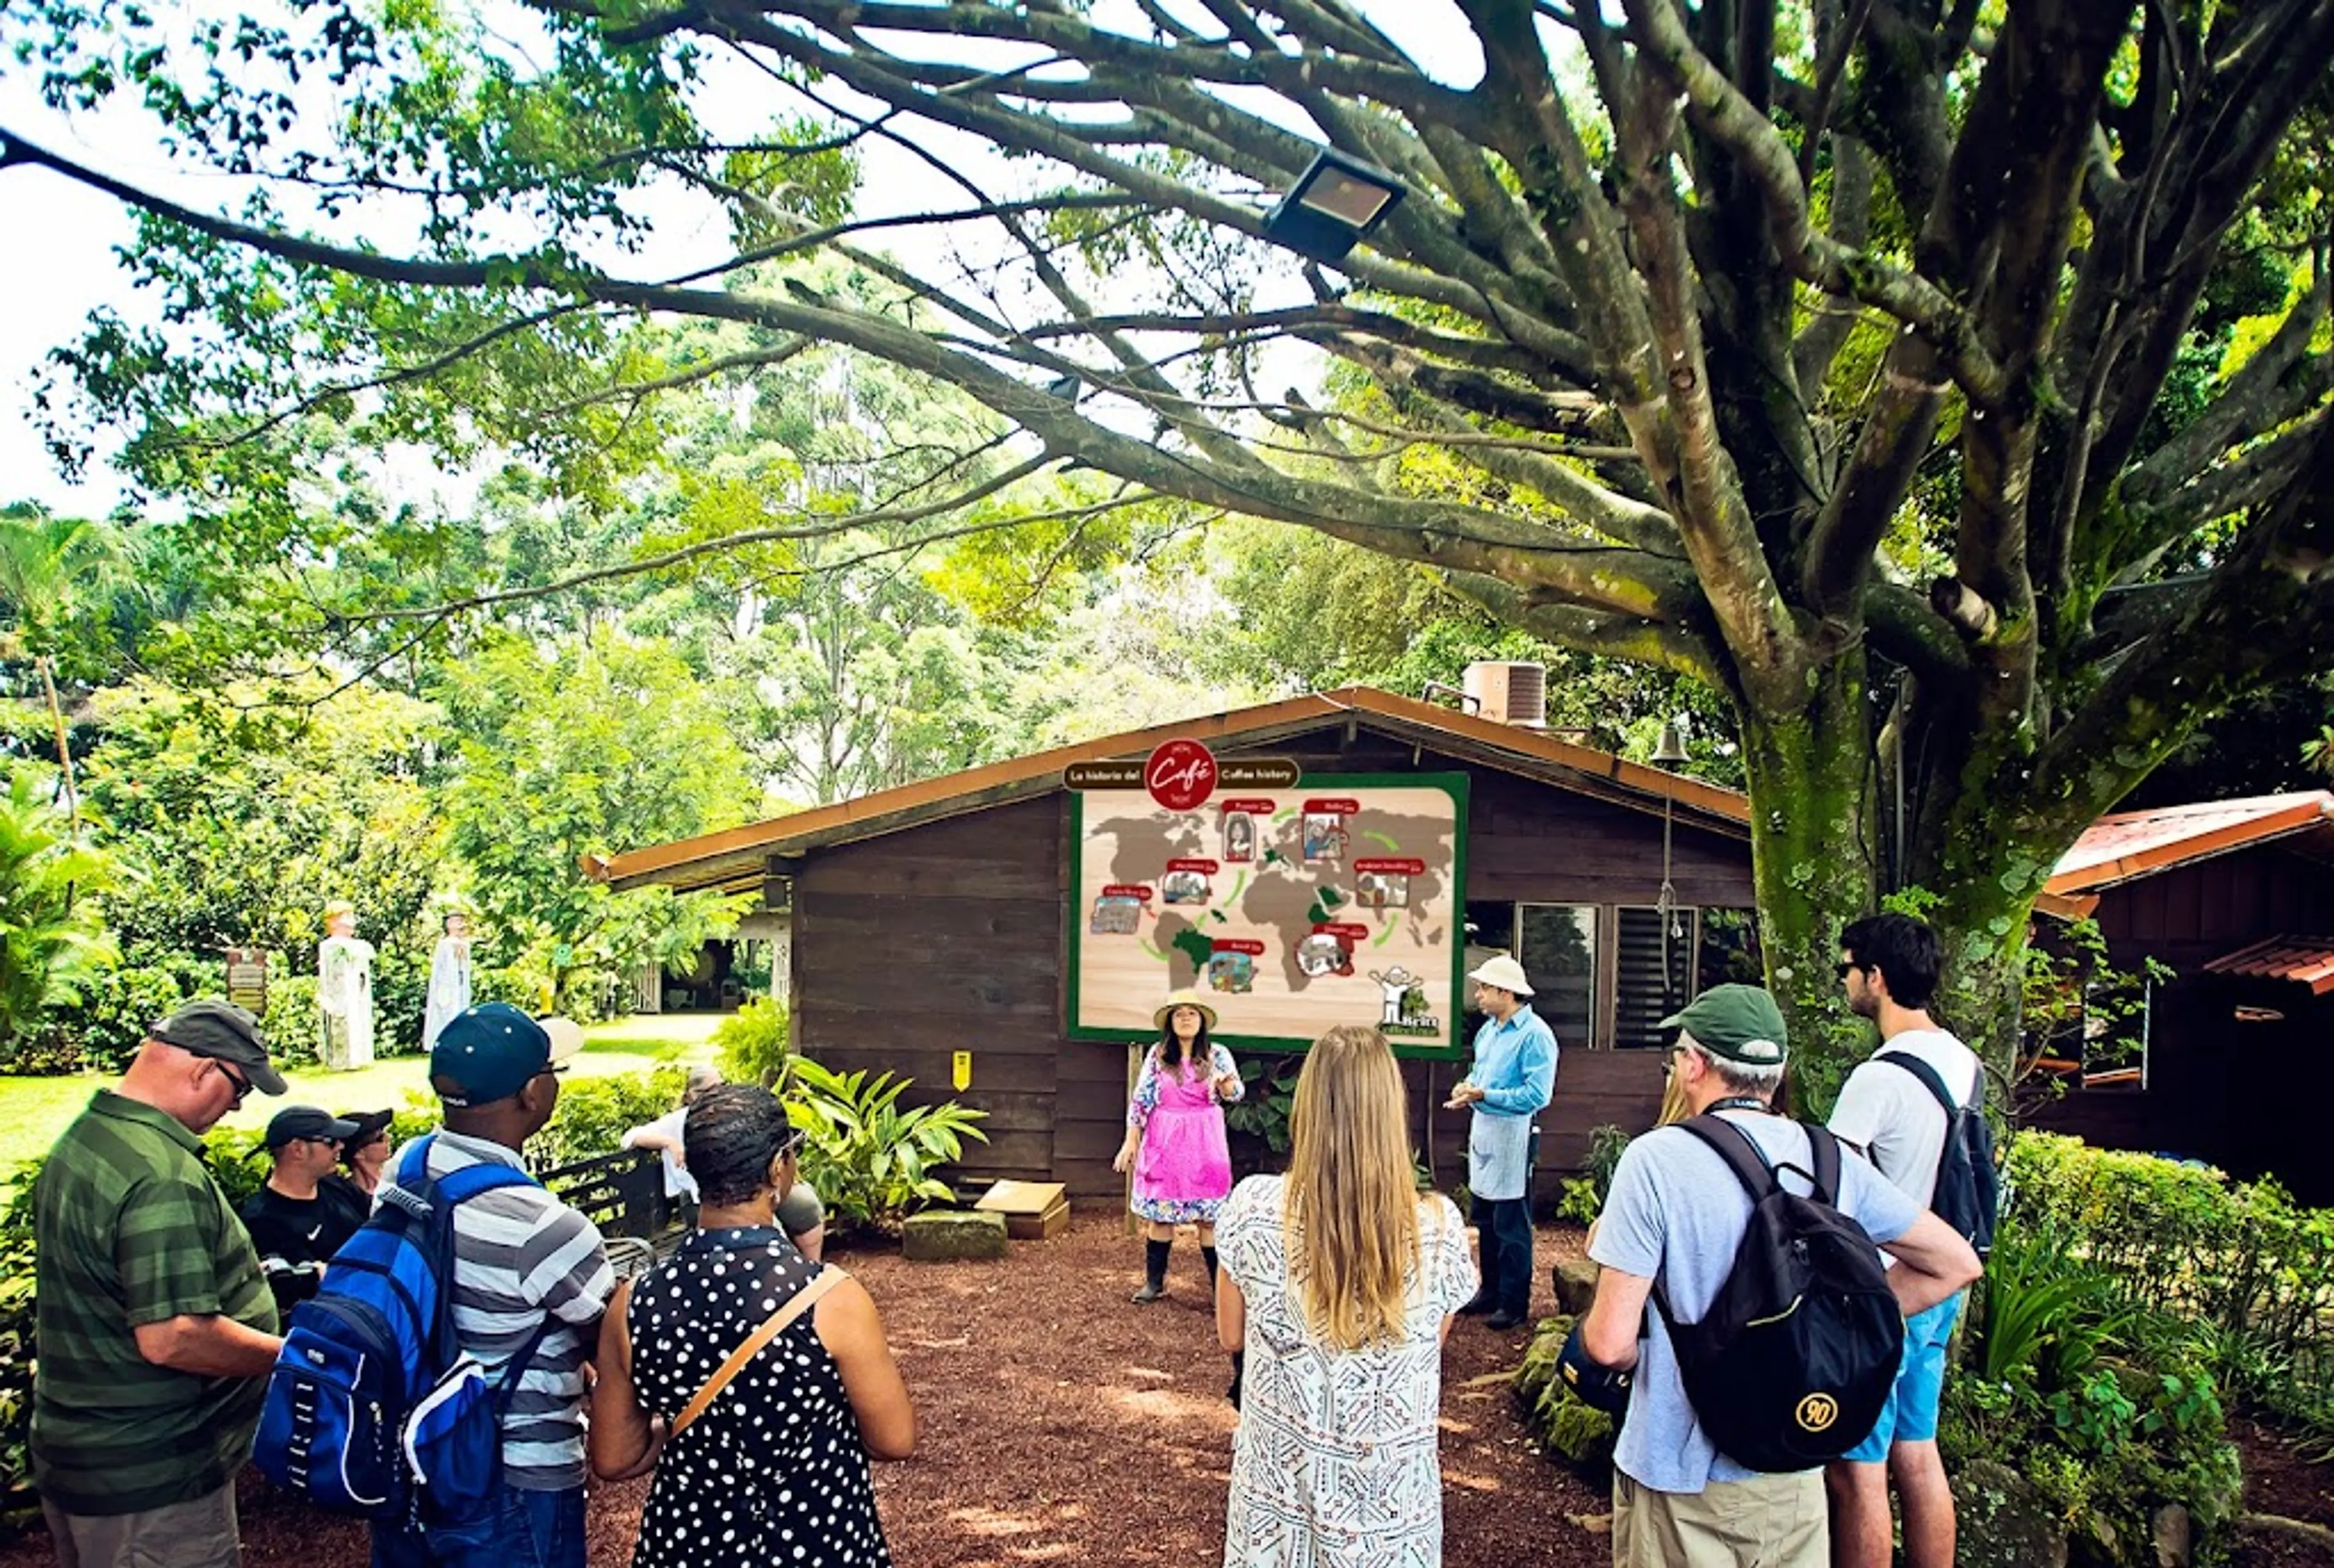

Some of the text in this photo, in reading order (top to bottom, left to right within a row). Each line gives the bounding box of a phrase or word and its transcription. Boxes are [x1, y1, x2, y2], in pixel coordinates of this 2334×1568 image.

[1070, 756, 1211, 792] La historia del Café
[1221, 767, 1292, 782] Coffee history
[1806, 1399, 1831, 1425] 90
